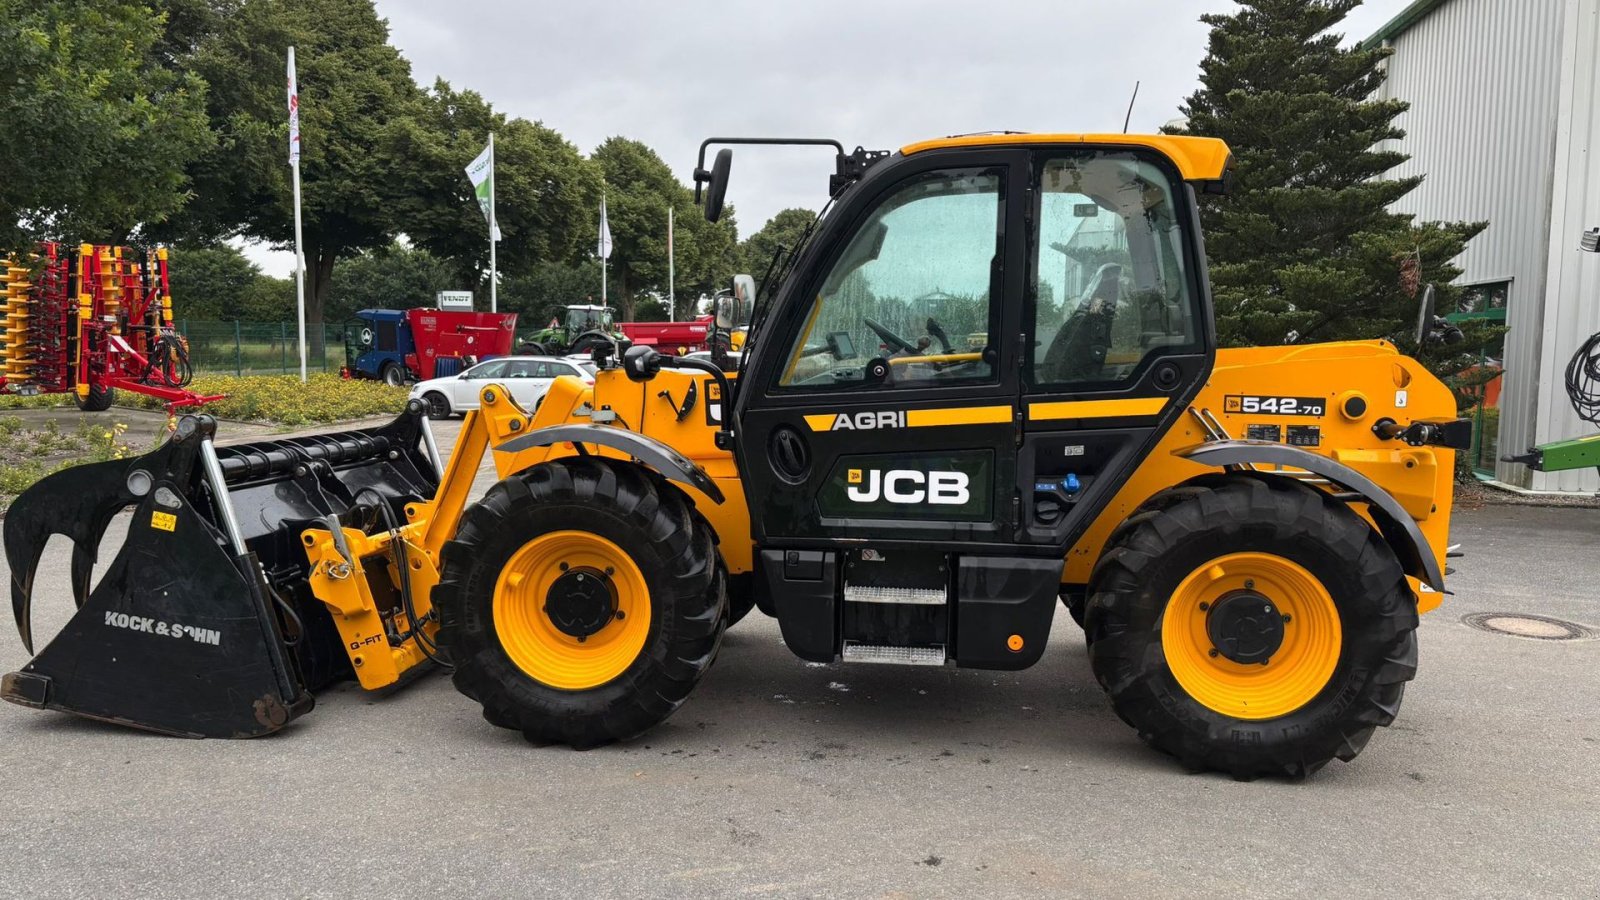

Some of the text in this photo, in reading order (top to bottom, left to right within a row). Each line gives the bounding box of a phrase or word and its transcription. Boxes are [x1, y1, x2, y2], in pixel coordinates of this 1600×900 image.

[1242, 397, 1322, 415] 542-70
[832, 410, 905, 431] AGRI
[847, 469, 970, 505] JCB
